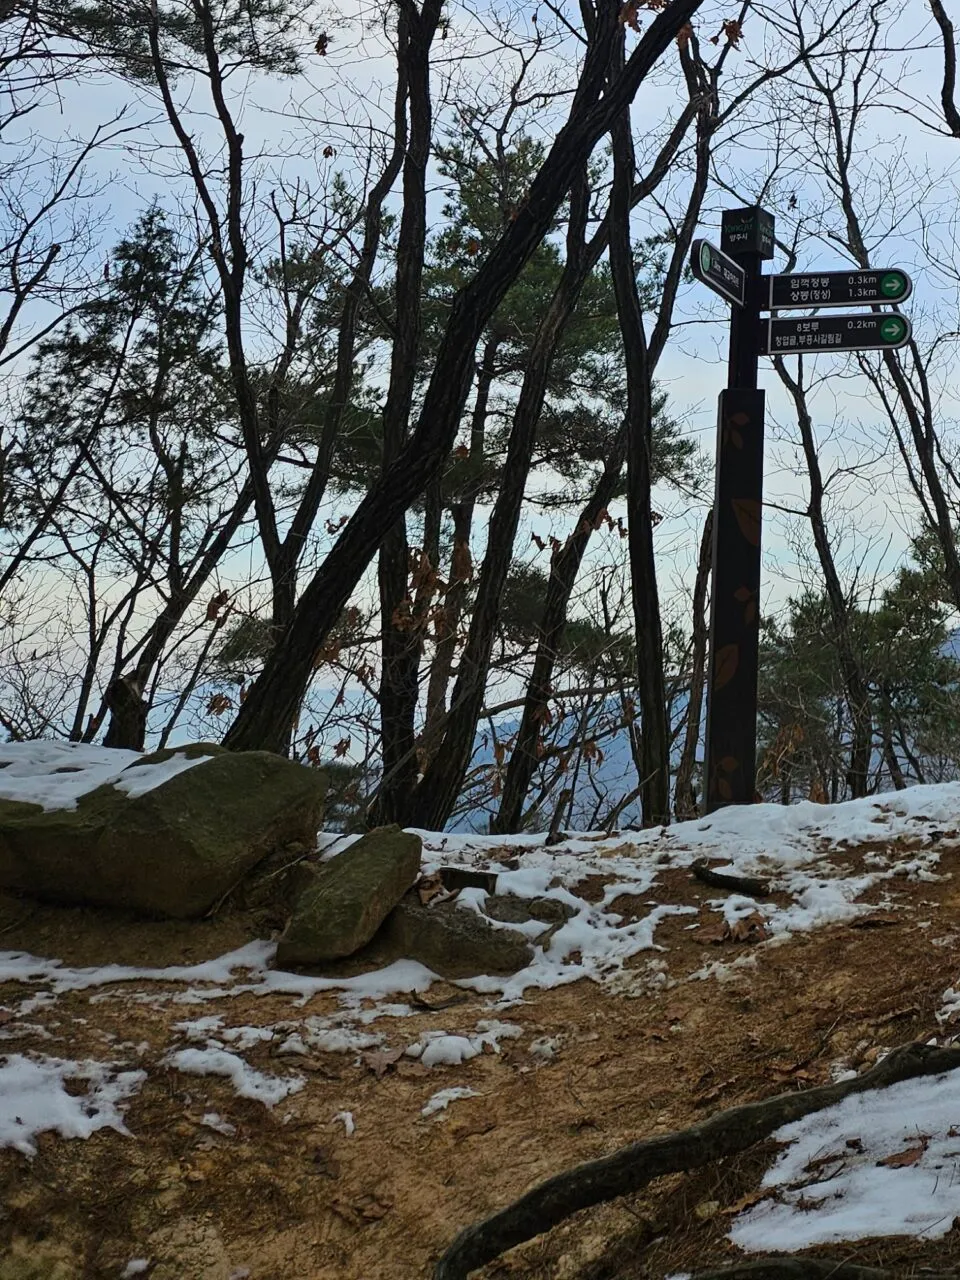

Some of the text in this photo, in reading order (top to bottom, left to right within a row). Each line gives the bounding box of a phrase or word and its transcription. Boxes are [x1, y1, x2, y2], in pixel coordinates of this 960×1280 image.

[790, 276, 877, 289] 임꺽정봉 0.3km
[790, 288, 877, 302] 상봉(정상) 1.3km
[796, 321, 877, 333] 8보루 0.2km
